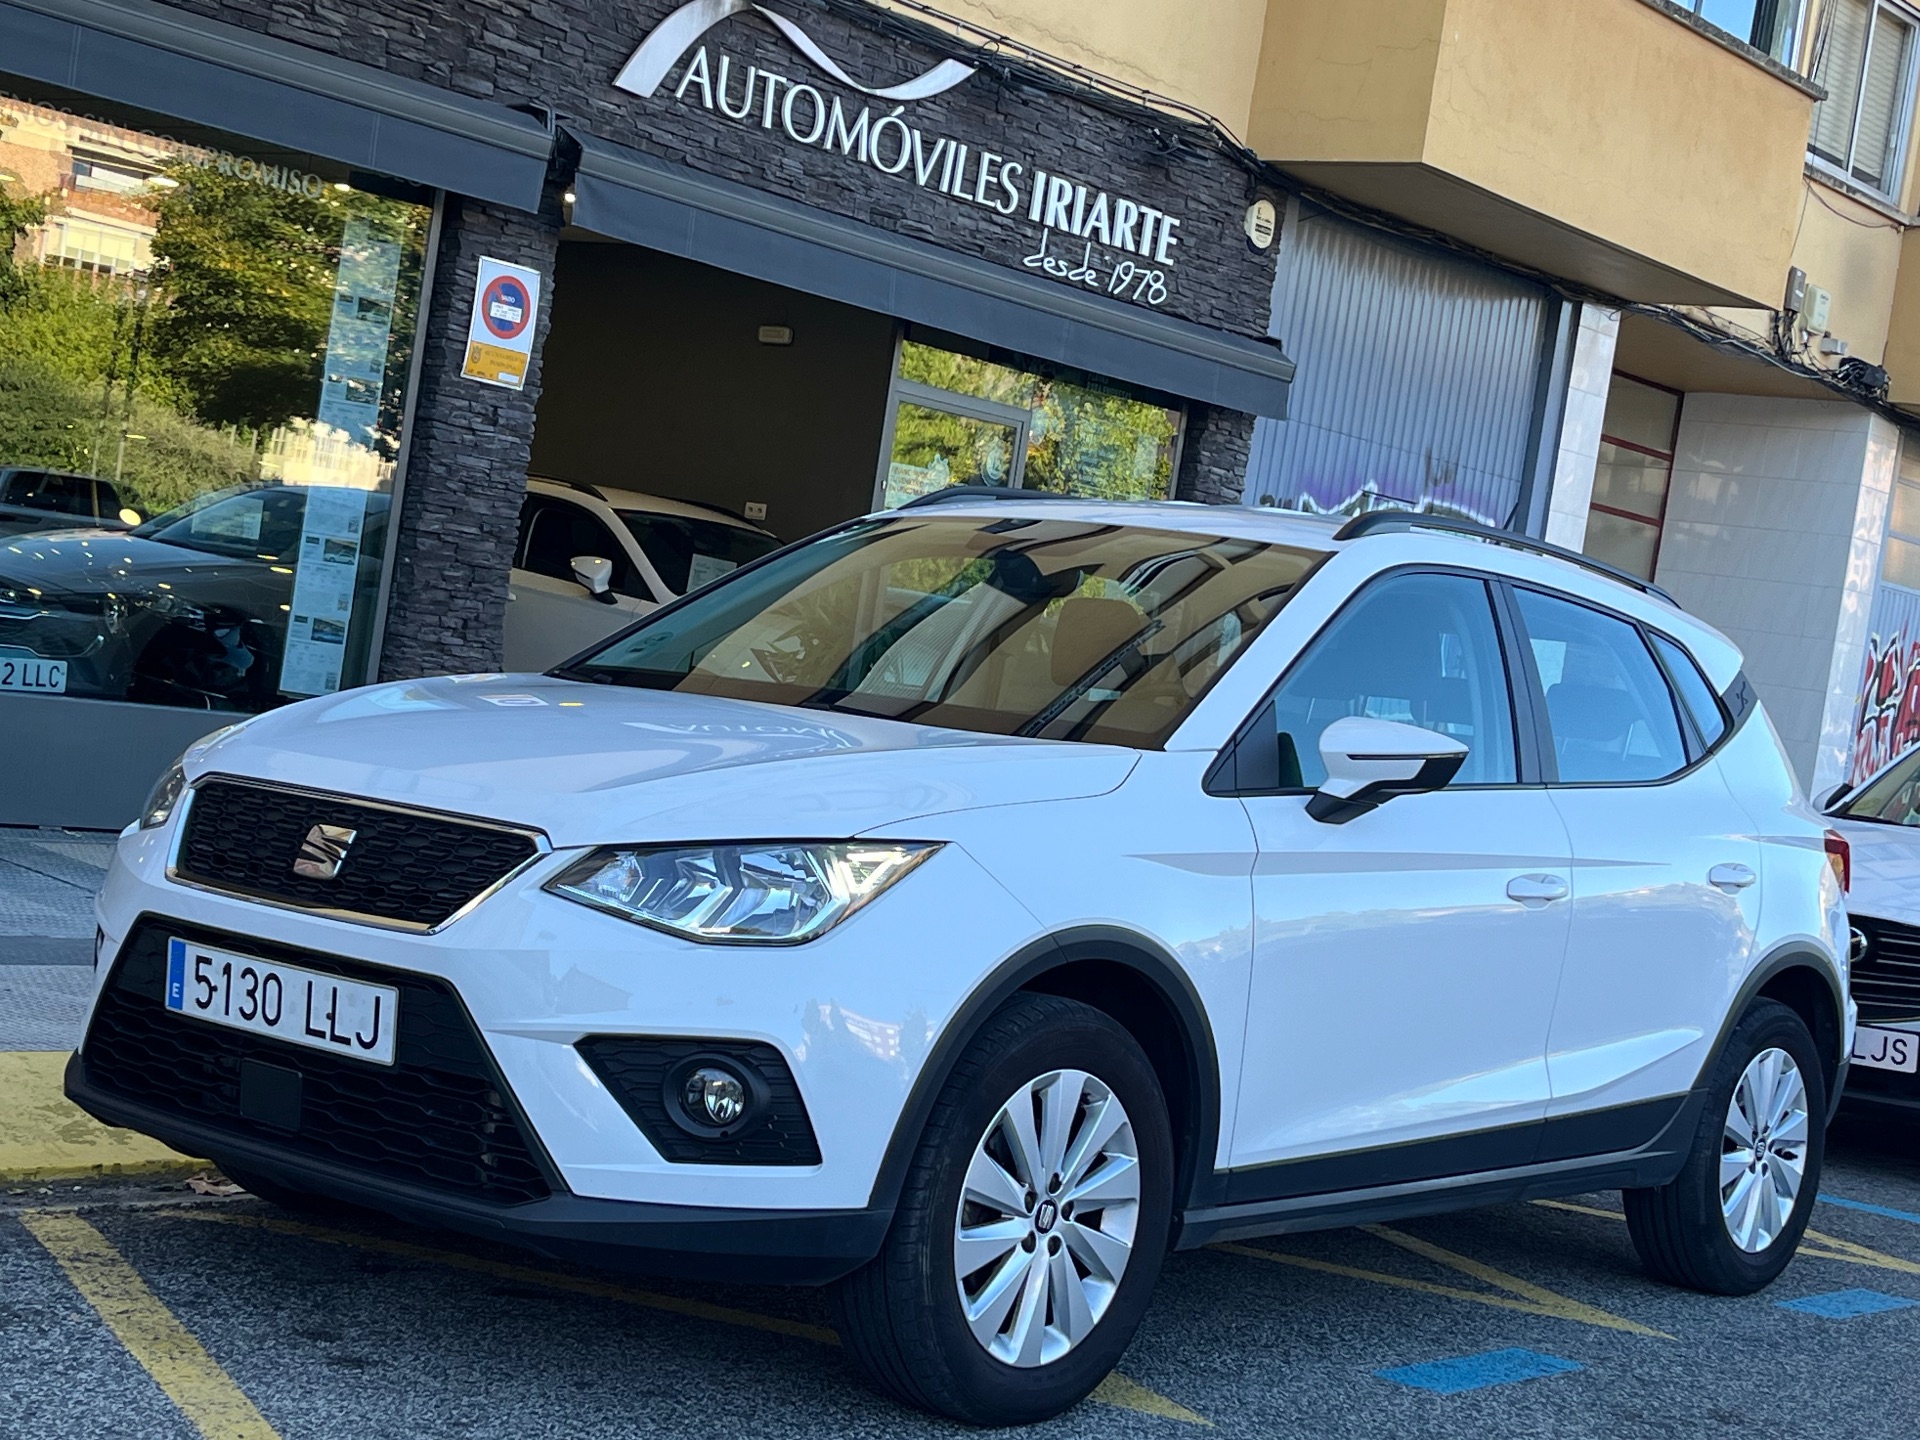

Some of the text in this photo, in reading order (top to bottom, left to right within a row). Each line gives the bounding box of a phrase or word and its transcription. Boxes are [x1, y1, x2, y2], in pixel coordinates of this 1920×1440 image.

[674, 45, 1181, 266] AUTOMÓVILES IRIARTE
[1022, 227, 1168, 305] desde 1978
[22, 663, 60, 688] LLC
[171, 954, 381, 1050] E 5130 LLJ
